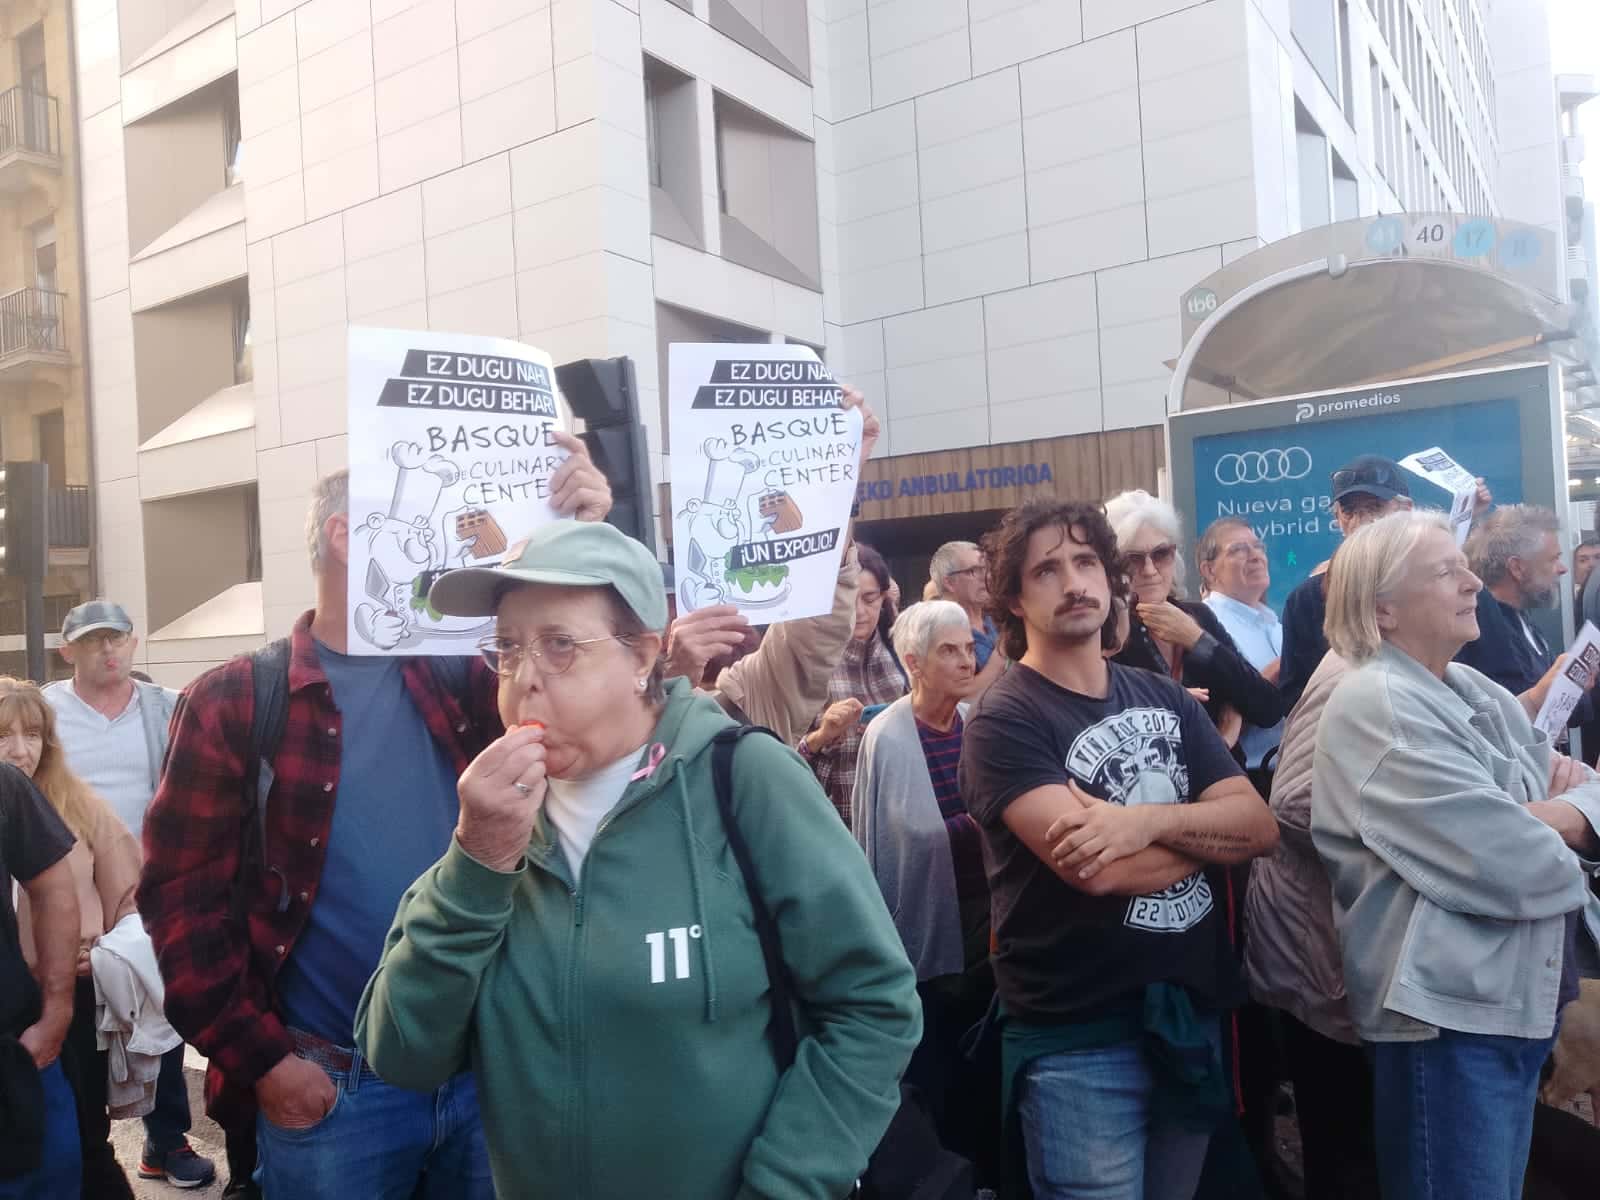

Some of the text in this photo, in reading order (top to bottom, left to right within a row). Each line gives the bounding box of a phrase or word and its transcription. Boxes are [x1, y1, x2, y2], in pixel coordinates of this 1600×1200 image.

[1416, 223, 1444, 243] 40
[427, 354, 450, 375] EZ
[456, 357, 512, 380] DUGU
[730, 362, 751, 380] EZ
[755, 363, 803, 381] DUGU
[407, 384, 433, 405] EZ
[438, 386, 496, 409] DUGU
[715, 389, 736, 406] EZ
[739, 389, 788, 407] DUGU
[1318, 392, 1401, 416] promedios
[427, 422, 560, 452] BASQUE
[731, 413, 849, 446] BASQUE
[768, 441, 858, 467] CULINARY
[763, 463, 854, 488] CENTER
[463, 478, 551, 505] CENTE
[1217, 495, 1331, 517] Nueva ga
[1251, 516, 1319, 539] ybrid
[740, 531, 833, 566] ¡UN EXPOLIO!
[1142, 712, 1180, 736] 2017
[1135, 901, 1160, 922] 22
